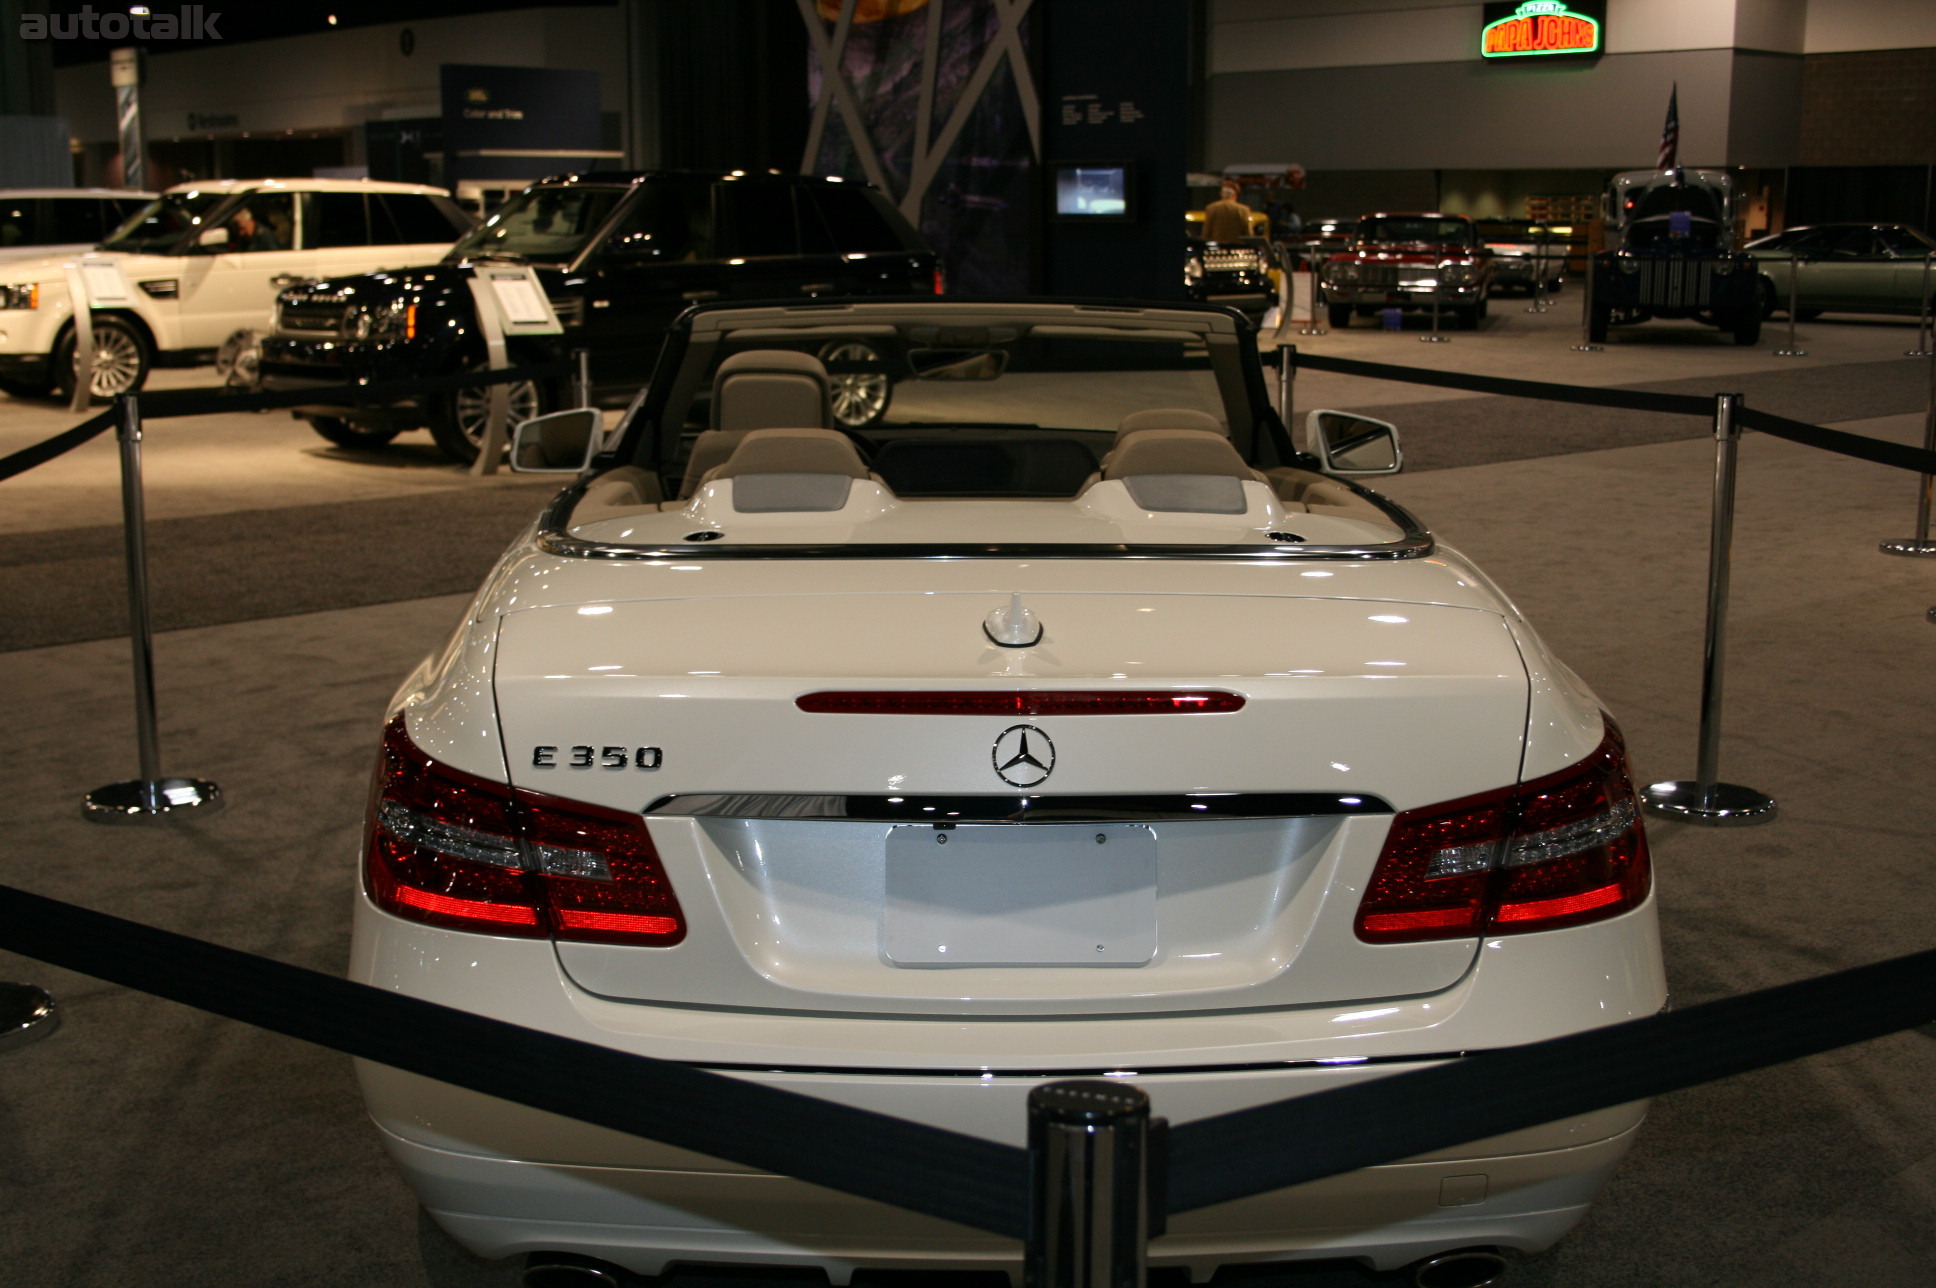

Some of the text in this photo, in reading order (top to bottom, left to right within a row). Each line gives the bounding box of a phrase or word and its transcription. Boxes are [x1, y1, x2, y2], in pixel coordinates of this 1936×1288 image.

[1486, 17, 1534, 52] PAPA
[533, 745, 663, 769] E 350
